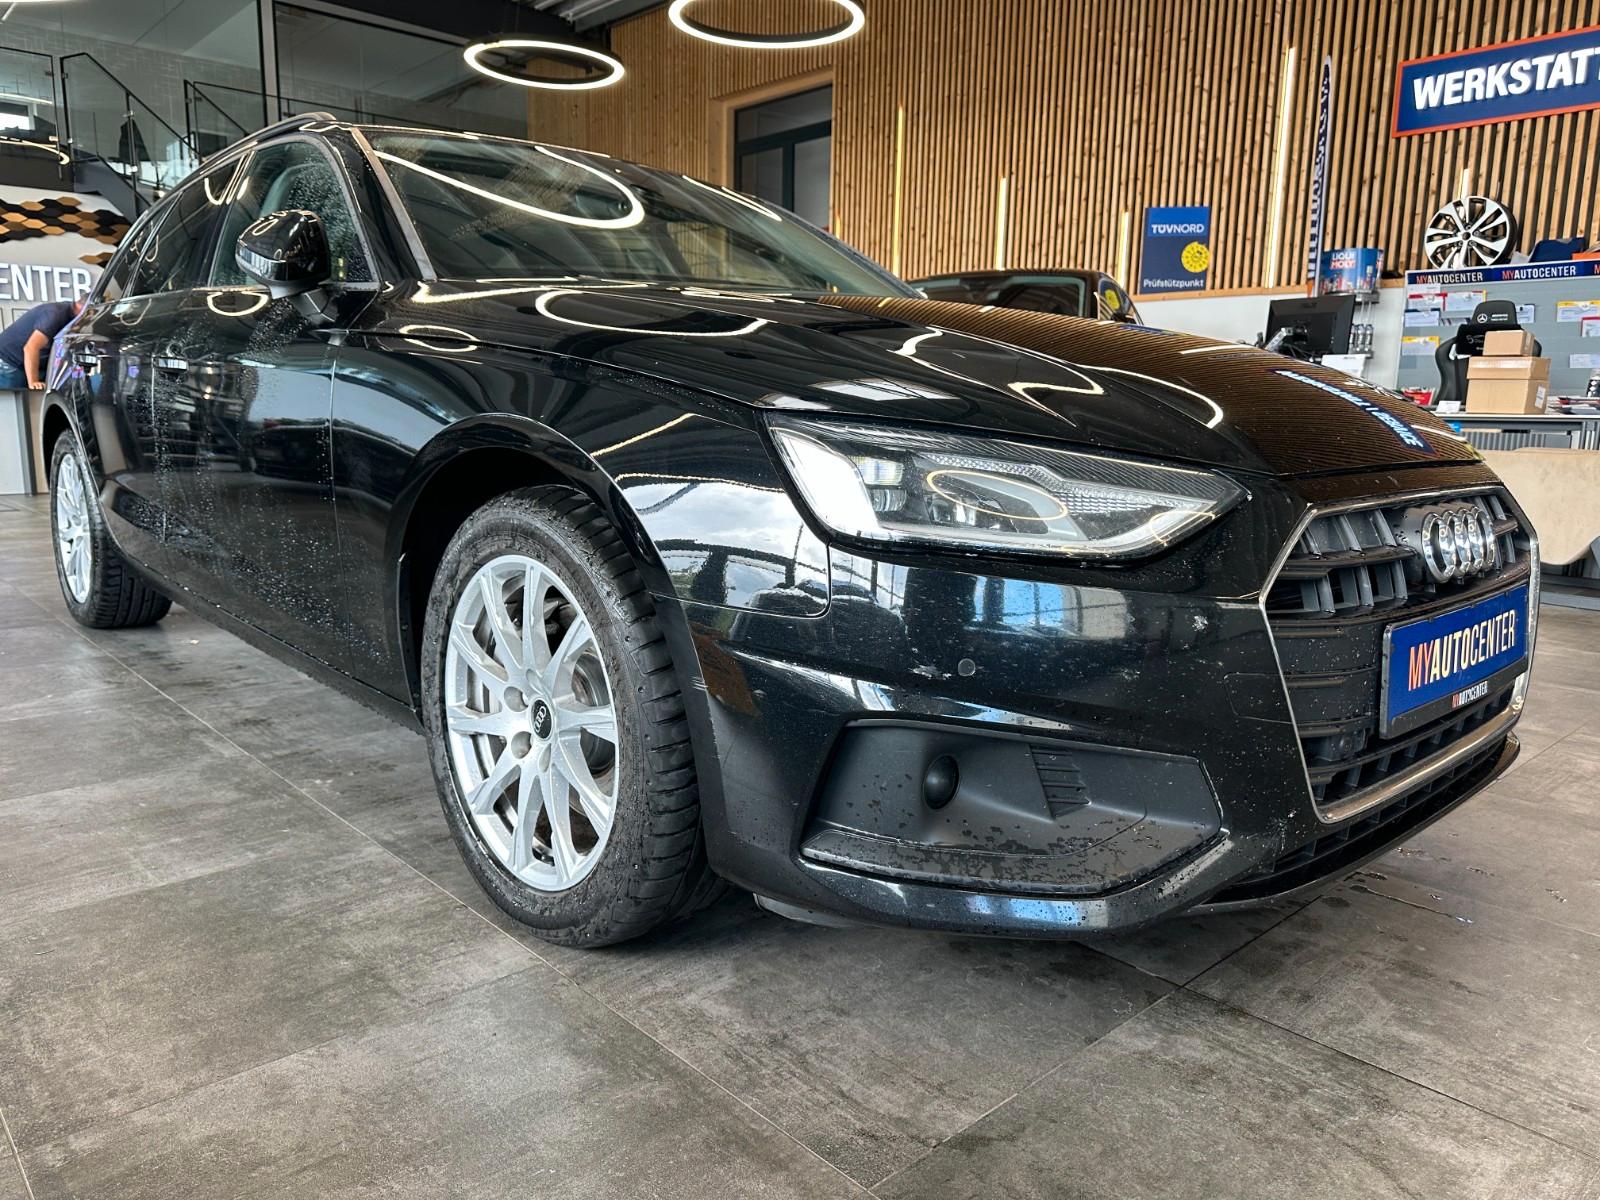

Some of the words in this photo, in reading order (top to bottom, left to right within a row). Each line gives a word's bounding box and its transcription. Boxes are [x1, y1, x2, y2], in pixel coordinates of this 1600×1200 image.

[1413, 47, 1600, 110] WERKSTAT
[1416, 271, 1483, 285] MYAUTOCENTER
[1502, 266, 1576, 280] MYAUTOCENTER
[1143, 278, 1204, 288] Prüfstützpunkt
[1408, 610, 1515, 691] MYAUTOCENTER
